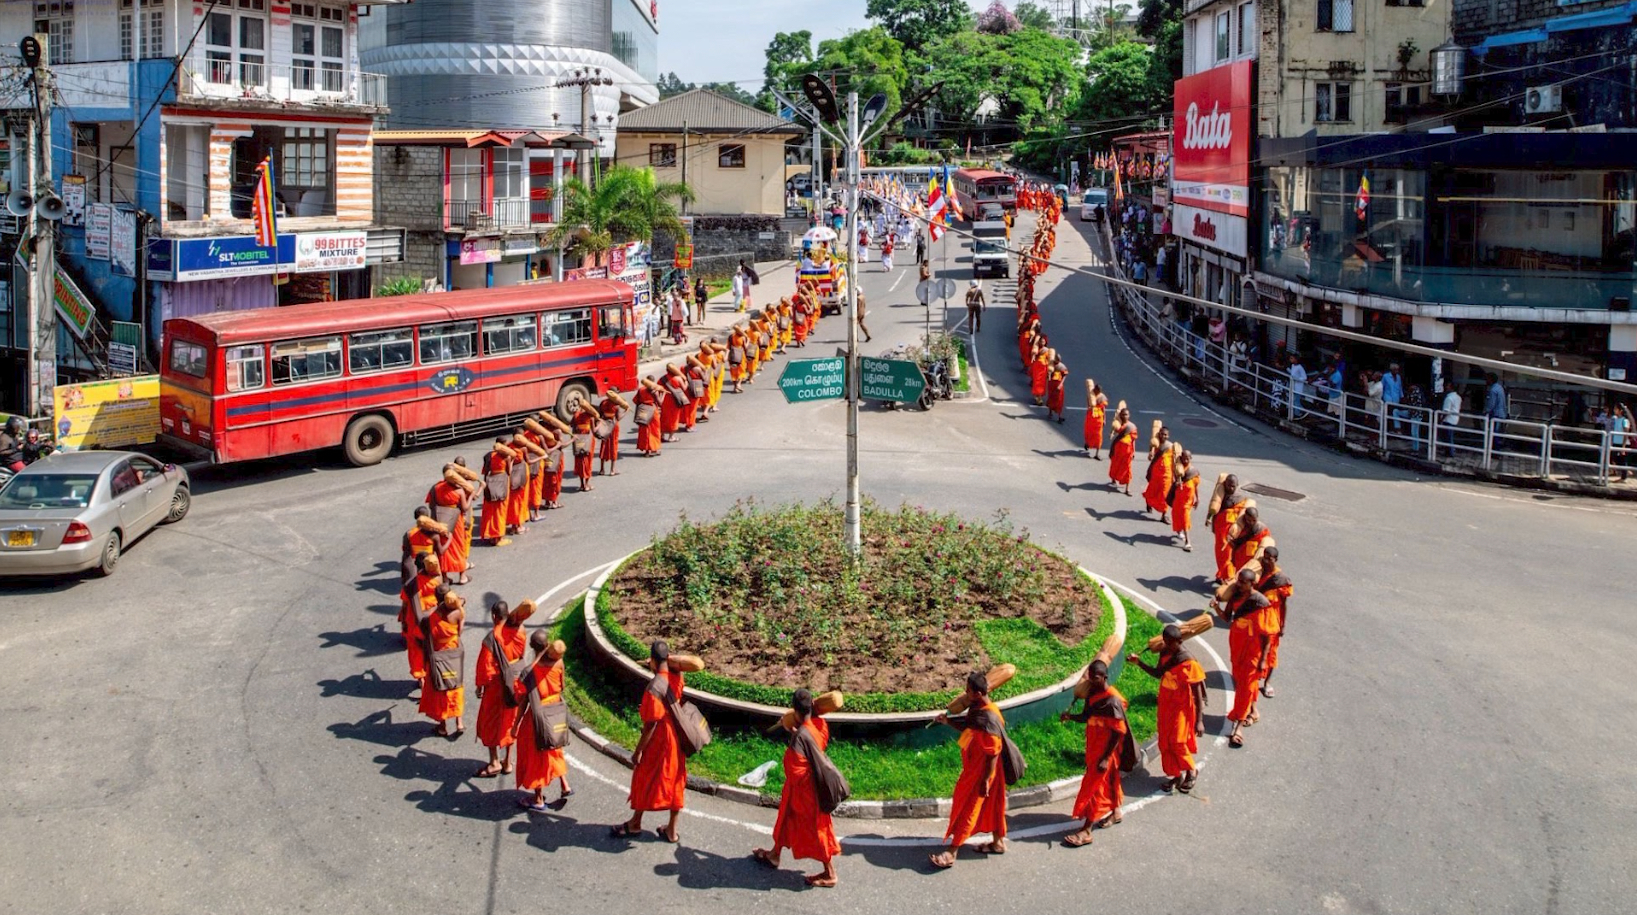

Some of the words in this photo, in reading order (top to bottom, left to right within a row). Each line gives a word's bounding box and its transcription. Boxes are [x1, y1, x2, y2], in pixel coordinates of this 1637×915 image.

[1183, 100, 1232, 149] Bata
[1193, 213, 1216, 241] Bata
[314, 238, 327, 250] 99
[328, 237, 366, 249] BITTES
[319, 248, 358, 257] MIXTURE
[798, 387, 842, 398] COLOMBO
[864, 386, 904, 398] BADULLA
